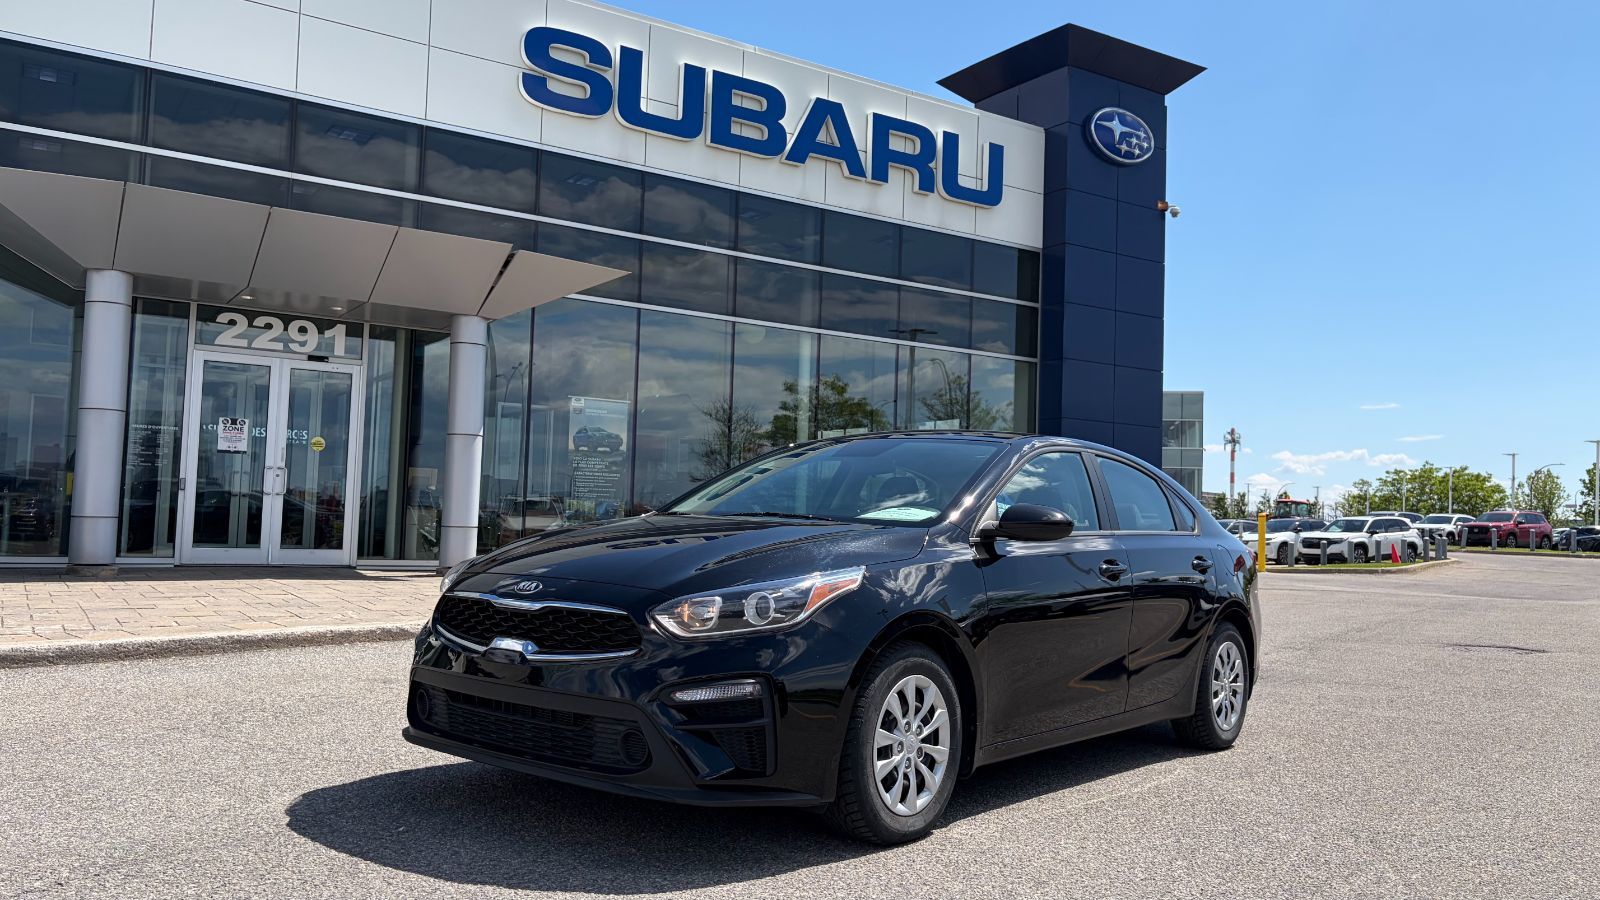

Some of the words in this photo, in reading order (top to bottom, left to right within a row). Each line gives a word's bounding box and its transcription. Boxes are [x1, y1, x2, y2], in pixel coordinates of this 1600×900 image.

[518, 26, 1005, 208] SUBARU
[214, 312, 347, 356] 2291
[222, 425, 245, 433] ZONE
[516, 580, 538, 591] KIA
